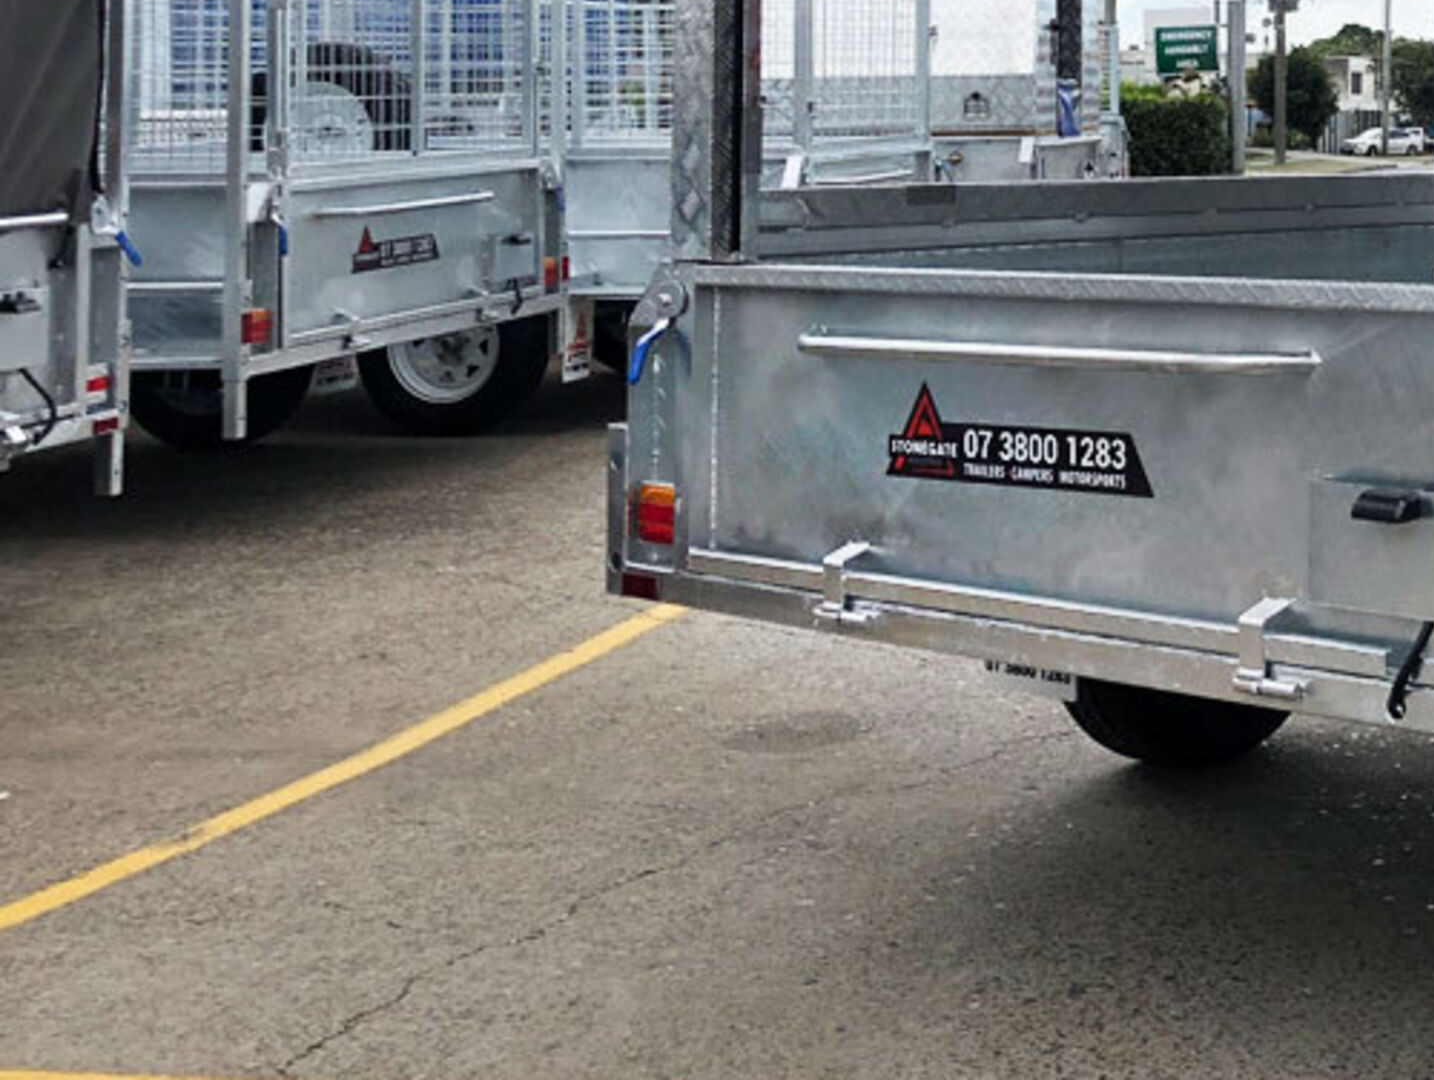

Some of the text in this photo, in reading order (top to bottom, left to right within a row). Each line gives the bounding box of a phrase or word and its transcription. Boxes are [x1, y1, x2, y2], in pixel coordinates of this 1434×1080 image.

[891, 439, 957, 459] STONEGATE
[963, 428, 1126, 470] 07 3800 1283
[963, 462, 1126, 490] TRAILERS CAMPERS MOTORSPORTS
